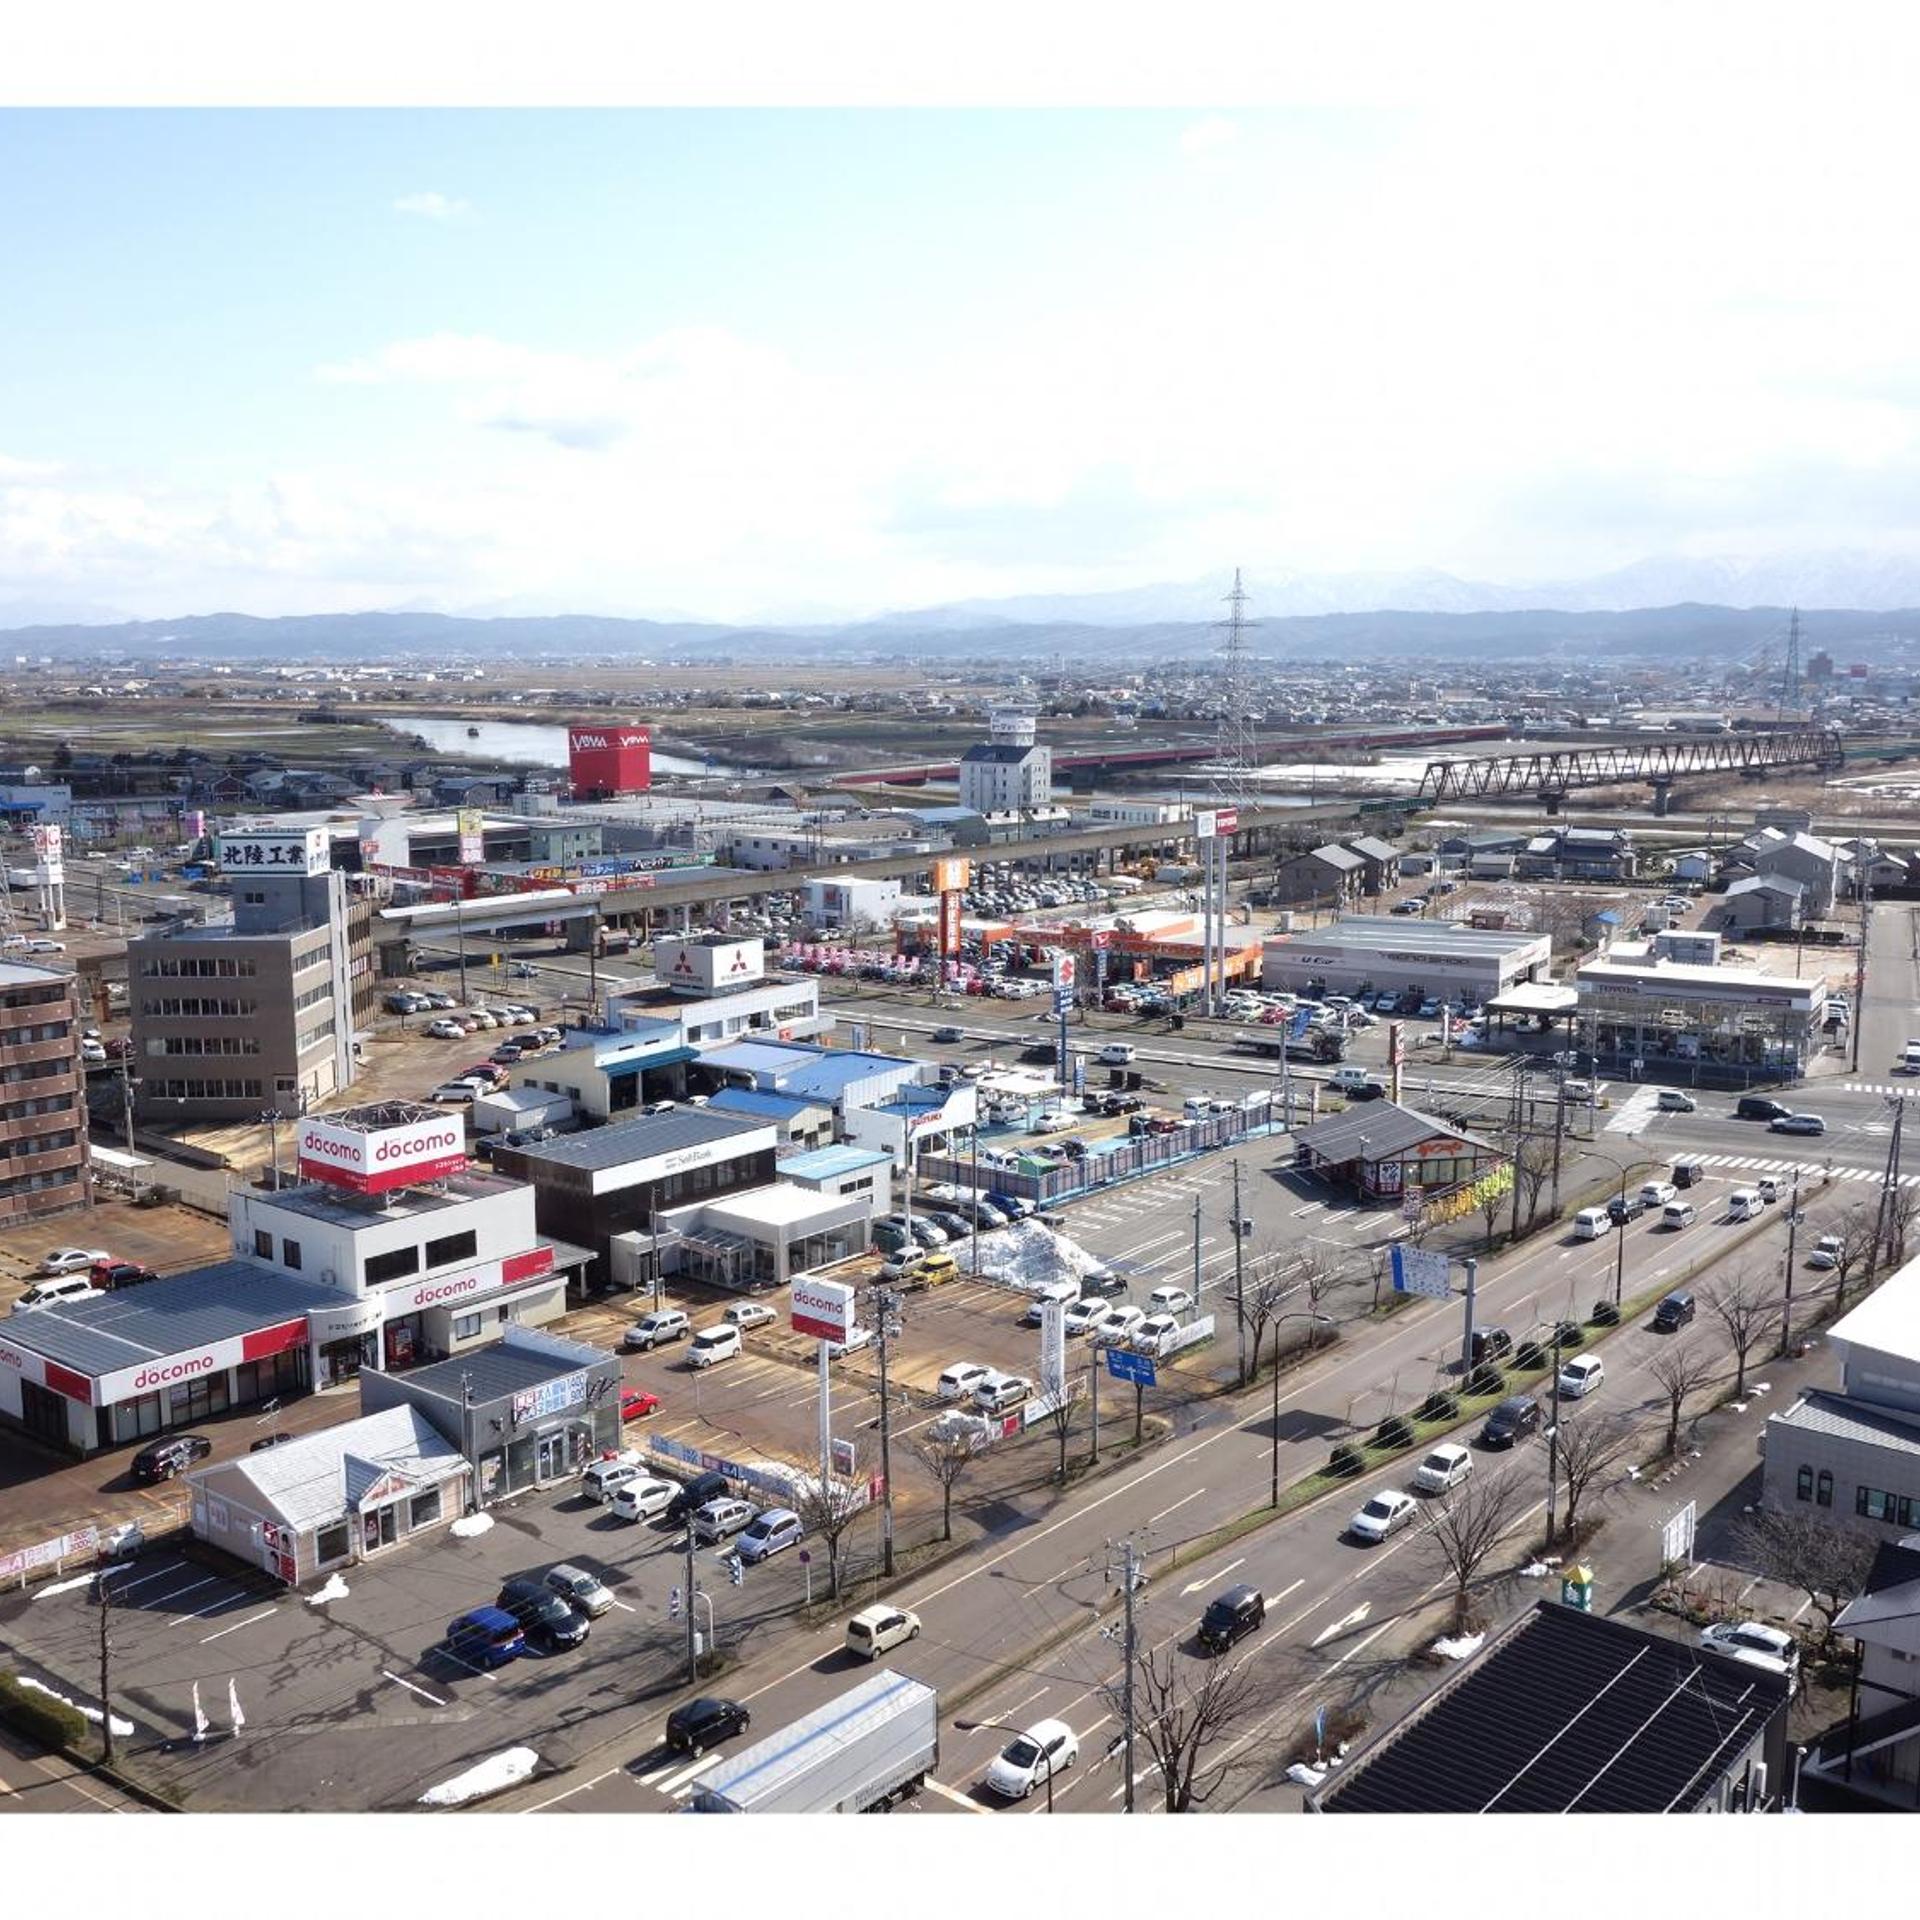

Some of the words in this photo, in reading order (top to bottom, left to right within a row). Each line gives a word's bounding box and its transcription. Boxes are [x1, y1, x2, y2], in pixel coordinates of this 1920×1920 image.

[223, 844, 305, 865] 北陸工業
[910, 1113, 942, 1127] SUZUKI
[305, 1131, 361, 1162] docomo
[375, 1132, 456, 1162] docomo
[415, 1277, 477, 1306] docomo
[794, 1289, 843, 1314] docomo
[134, 1355, 214, 1389] docomo
